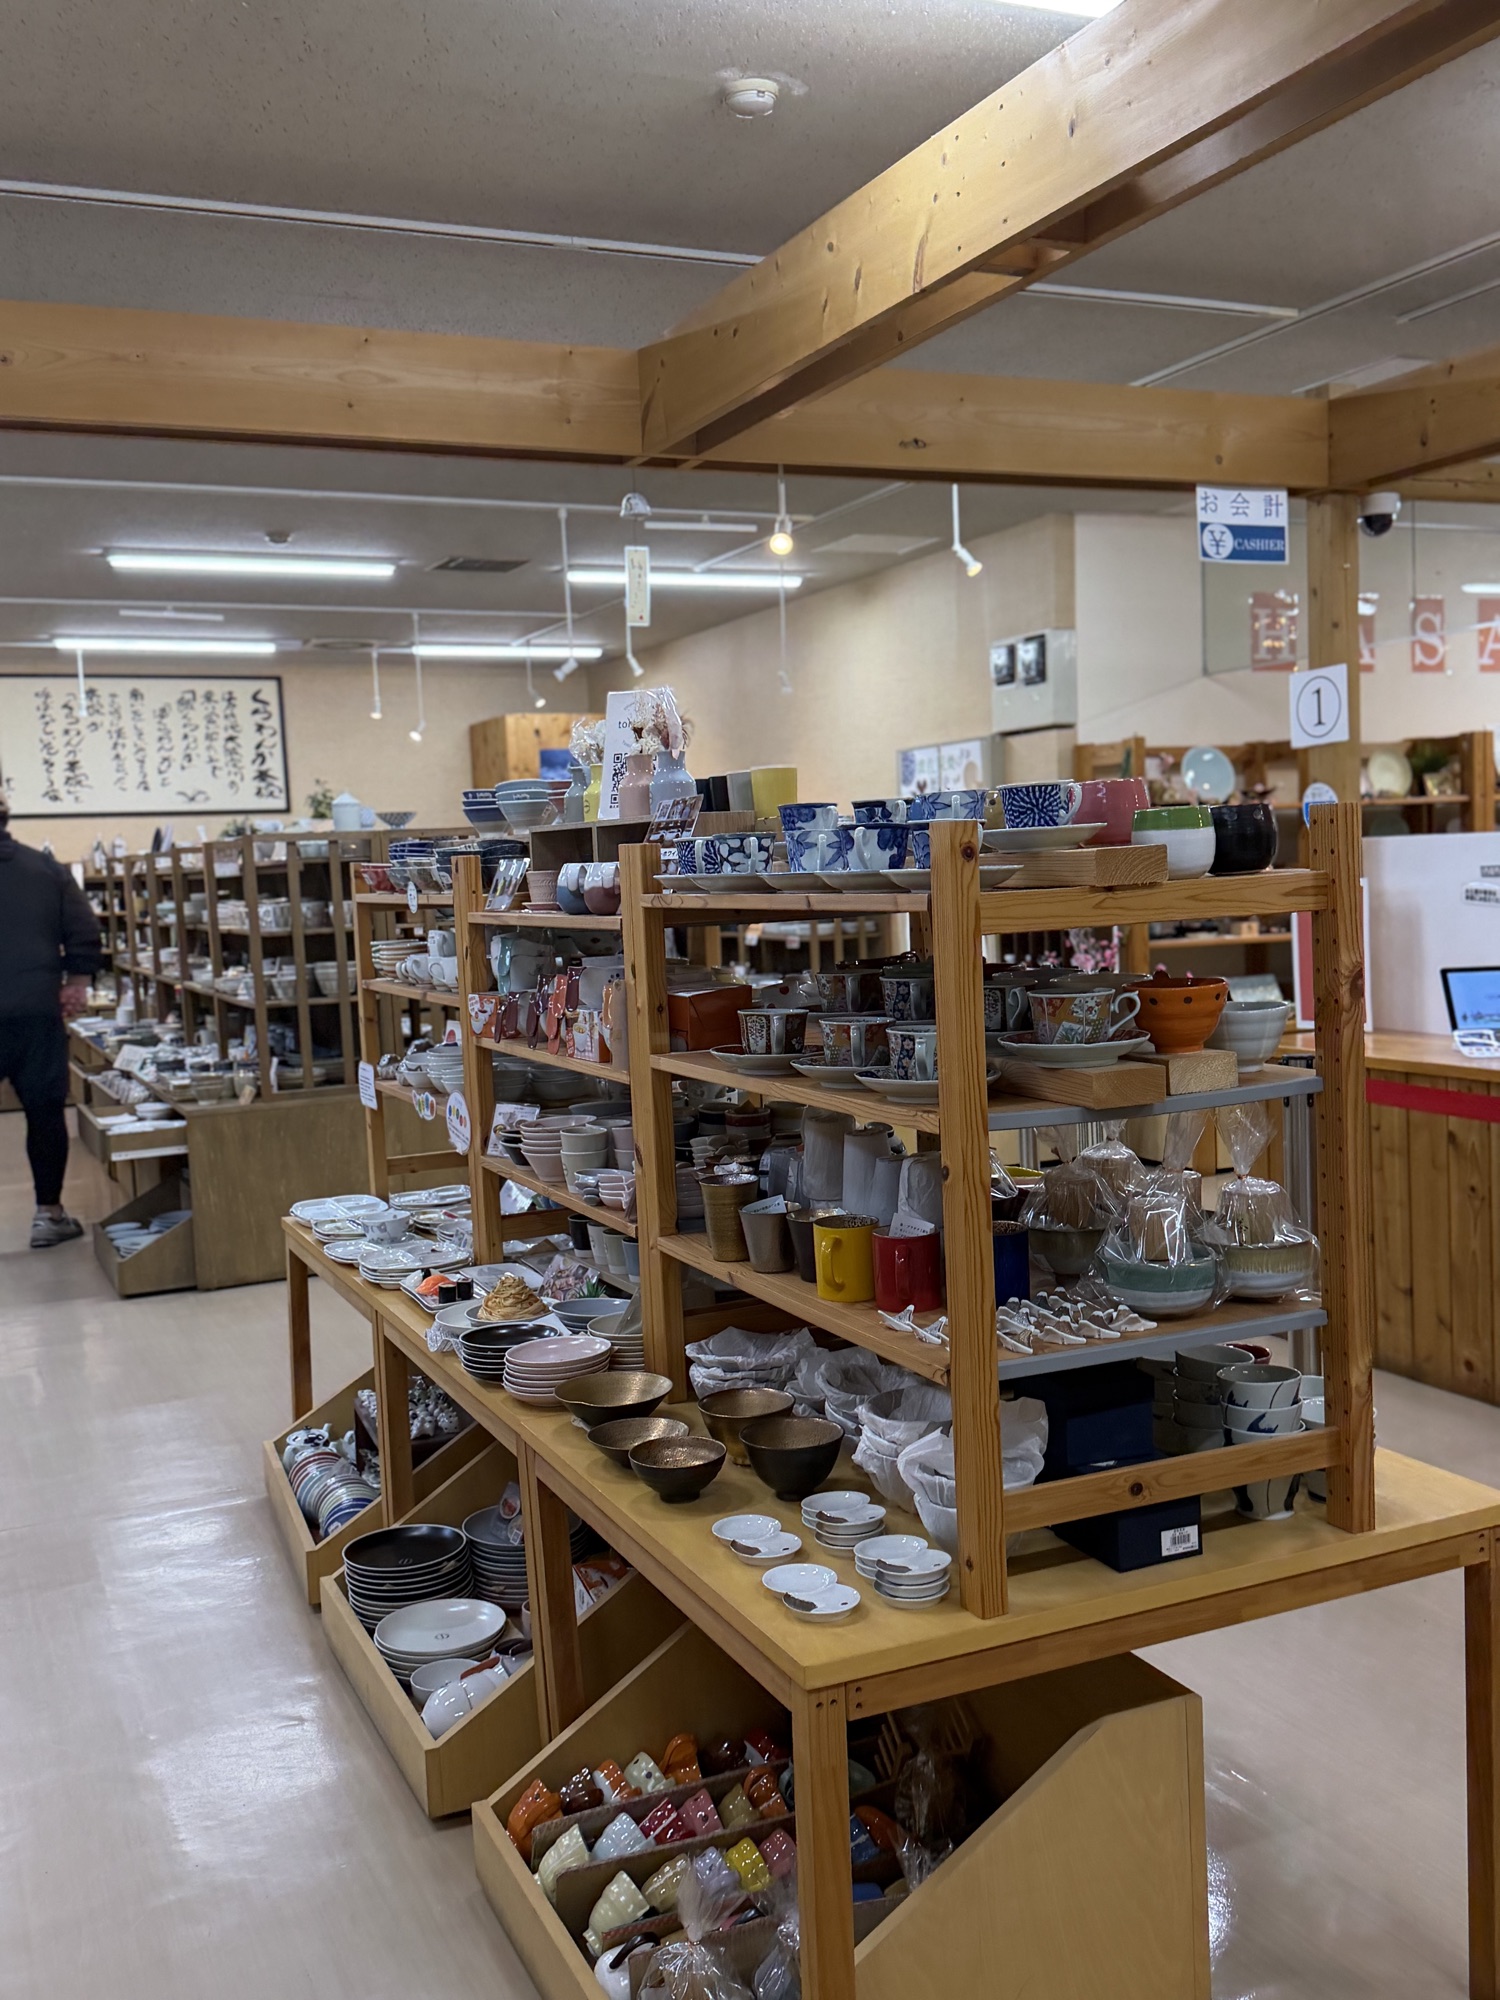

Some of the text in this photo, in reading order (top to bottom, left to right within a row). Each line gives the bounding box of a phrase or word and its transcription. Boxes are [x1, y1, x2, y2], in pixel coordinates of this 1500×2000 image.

[1200, 491, 1283, 518] お会計
[1234, 538, 1284, 551] CASHIER
